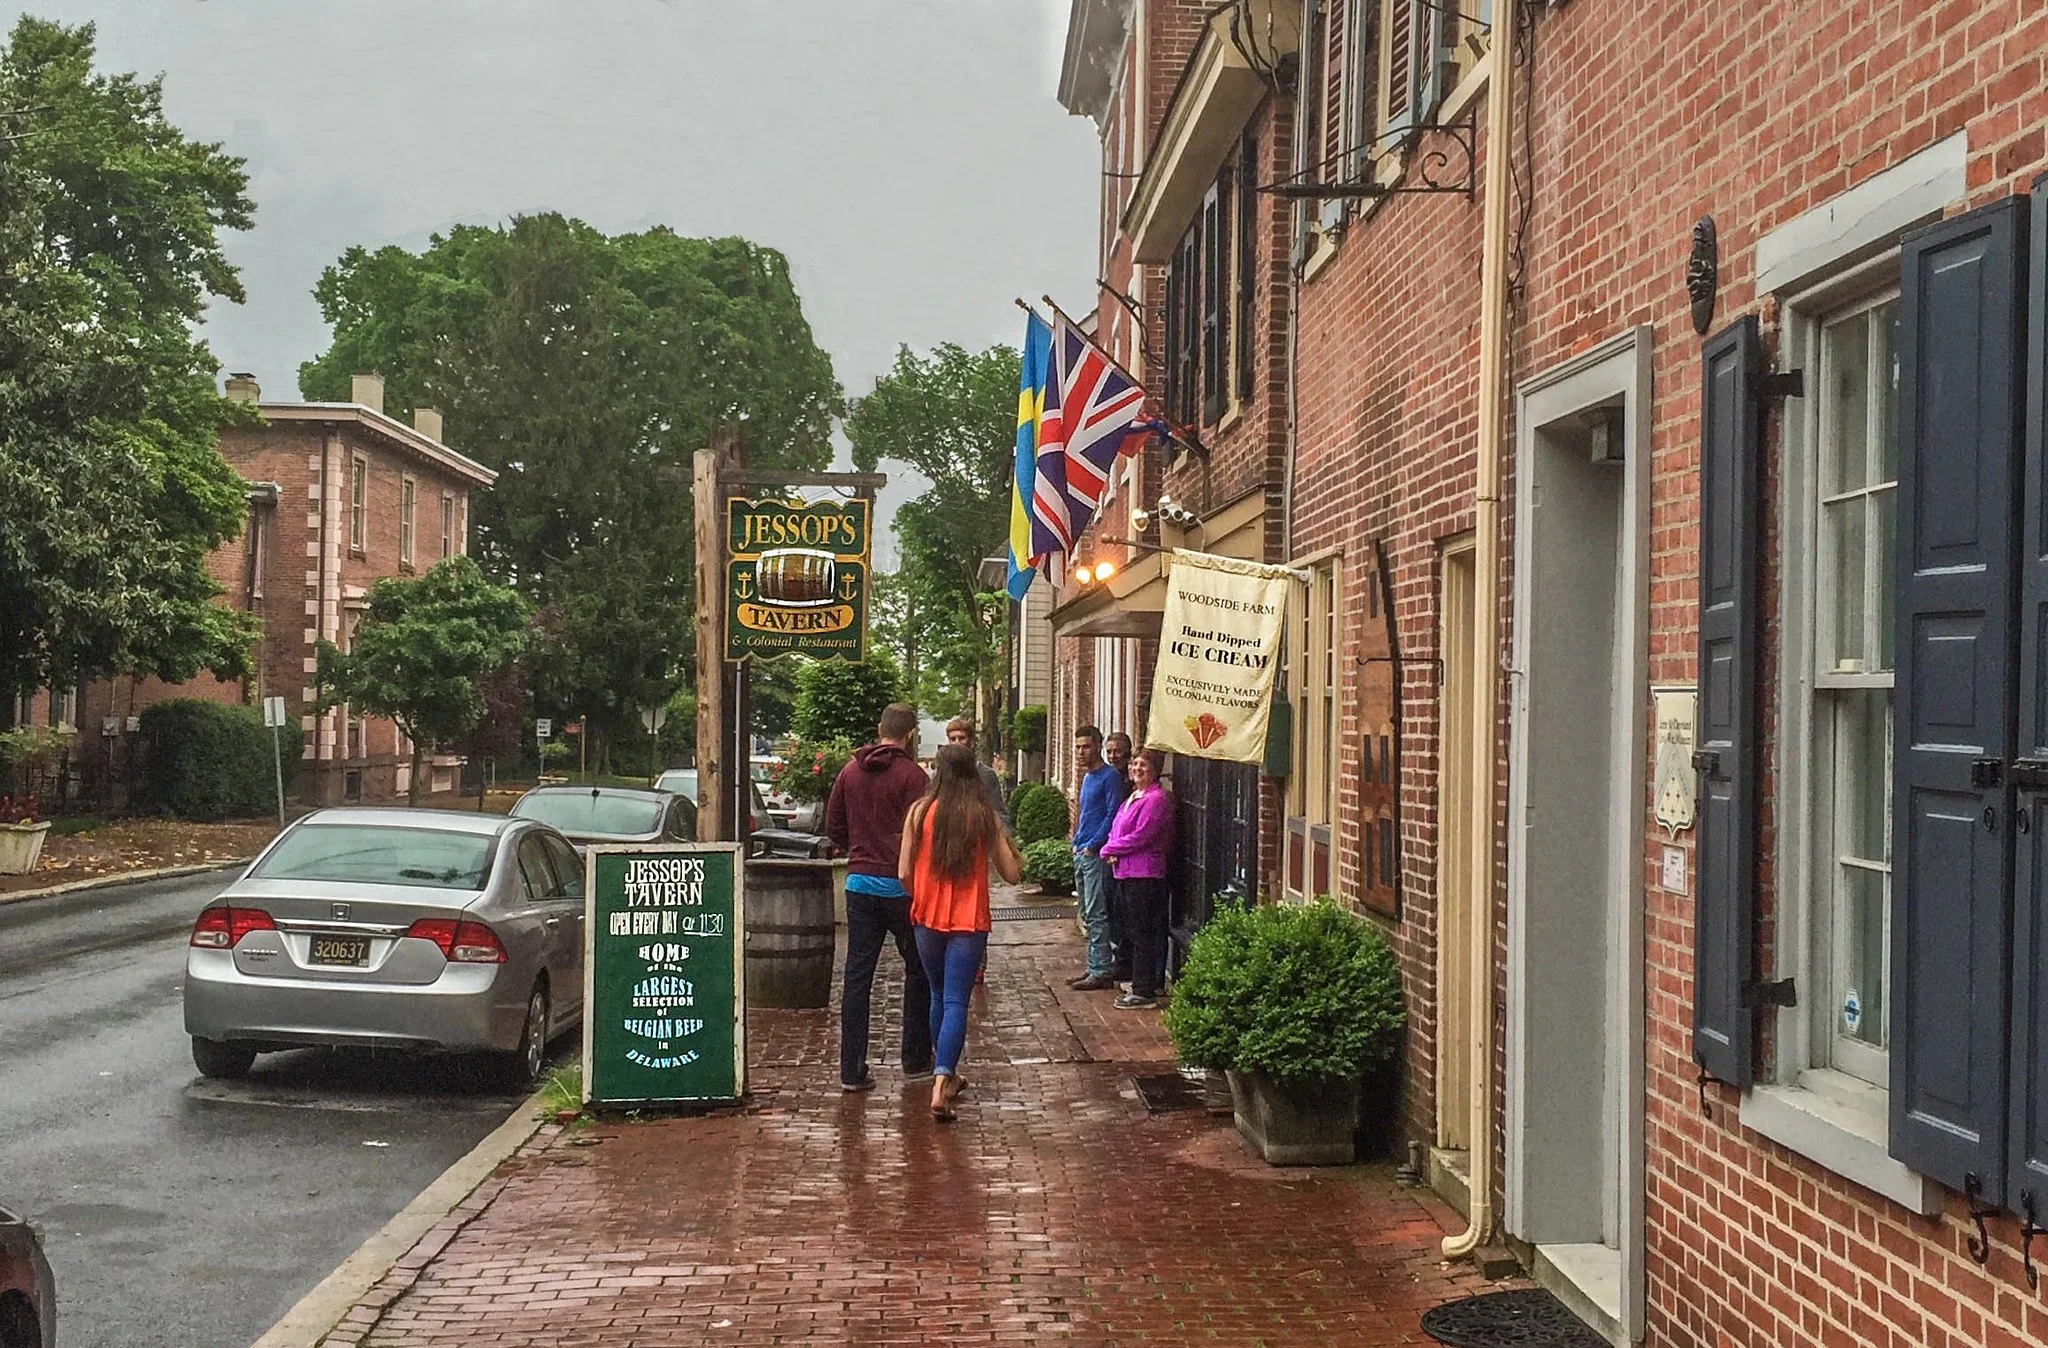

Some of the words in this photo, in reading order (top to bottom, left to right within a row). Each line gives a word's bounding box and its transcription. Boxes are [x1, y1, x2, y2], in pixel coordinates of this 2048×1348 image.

[738, 514, 857, 550] JESSOP'S
[1178, 590, 1240, 611] WOODSIDE
[1242, 602, 1275, 616] FARM
[748, 607, 842, 630] TAVERN
[746, 635, 792, 647] Colonial
[798, 637, 857, 649] Restaurant
[1181, 625, 1214, 641] Hand
[1216, 632, 1262, 649] Dipped
[1170, 640, 1200, 659] ICE
[1204, 647, 1269, 669] CREAM
[1165, 686, 1213, 704] COLONIAL
[1215, 695, 1260, 709] FLAVORS
[1166, 674, 1230, 695] EXCLUSIVELY
[1232, 685, 1261, 698] MADE
[624, 859, 705, 883] JESSOP'S
[624, 882, 703, 907] TAVERN
[610, 911, 631, 936] OPEN
[632, 911, 660, 935] EVERY
[662, 910, 679, 935] DAY
[314, 940, 365, 959] 320637
[638, 942, 690, 962] HOME
[646, 963, 659, 973] of
[663, 963, 683, 973] the
[633, 975, 694, 997] LARGEST
[632, 996, 694, 1007] SELECTION
[656, 1007, 668, 1017] of
[624, 1018, 672, 1039] BELGIAN
[675, 1018, 704, 1038] BEER
[625, 1048, 700, 1069] DELAWARE
